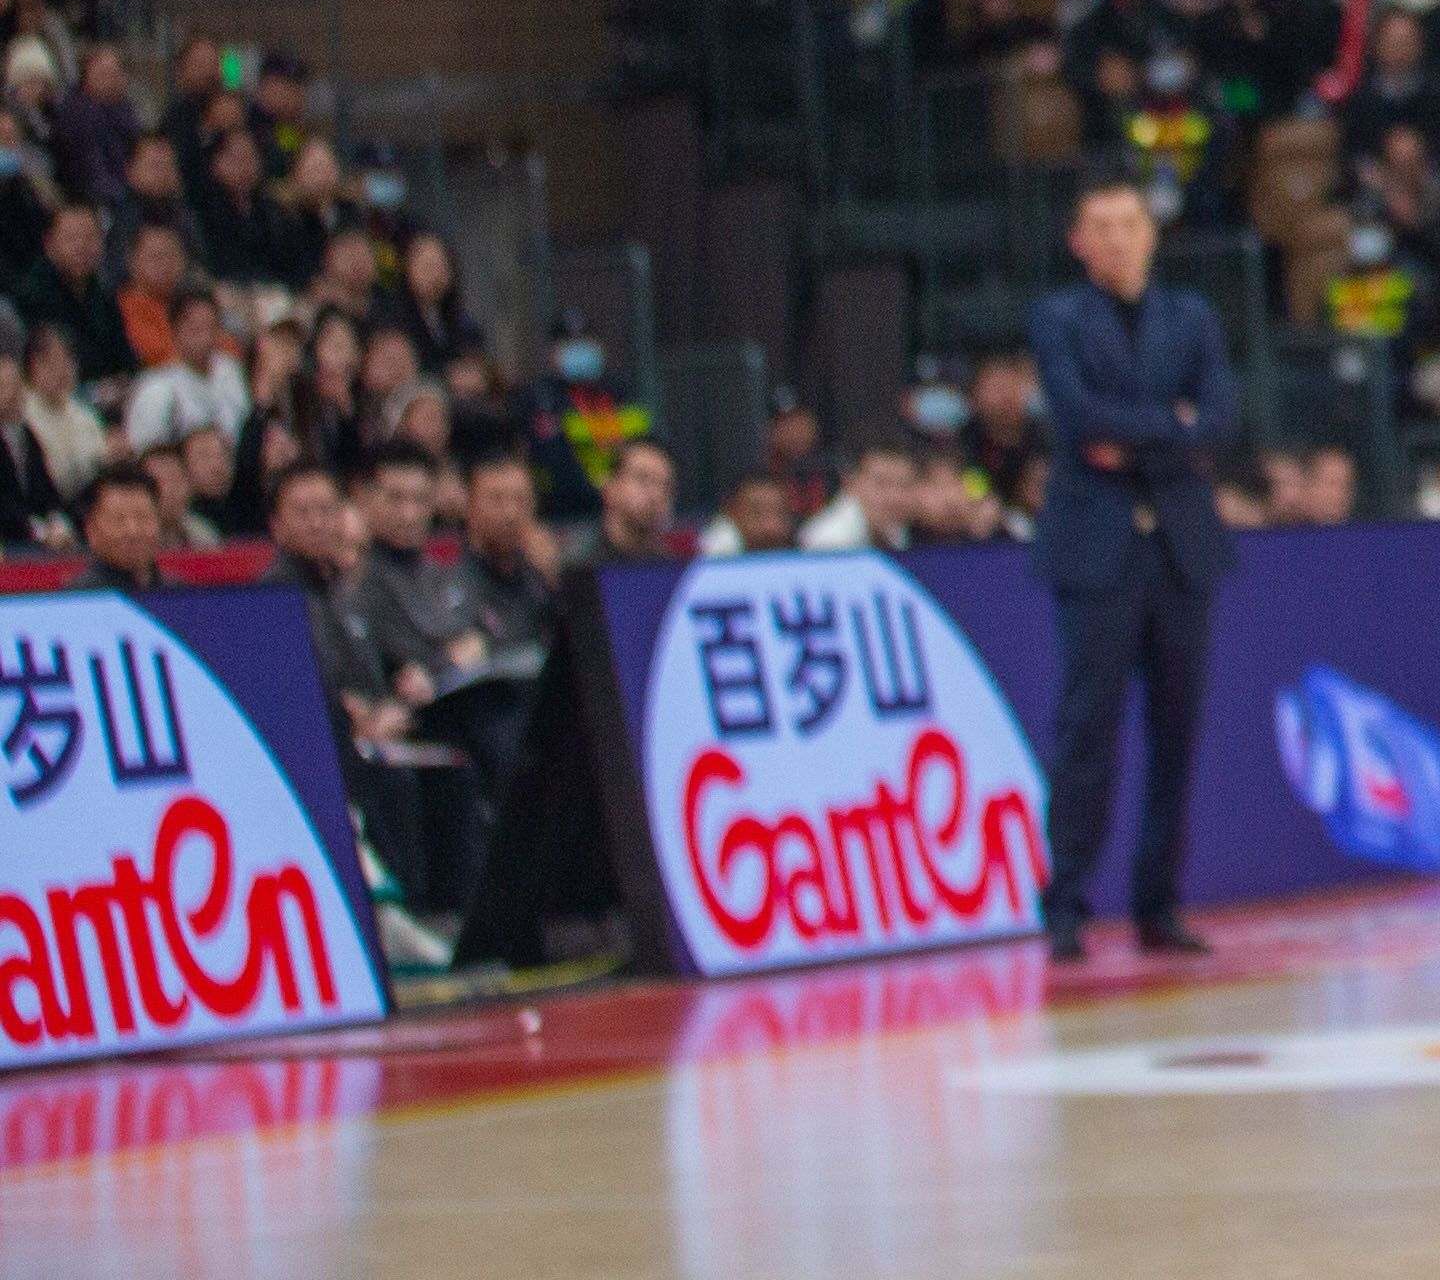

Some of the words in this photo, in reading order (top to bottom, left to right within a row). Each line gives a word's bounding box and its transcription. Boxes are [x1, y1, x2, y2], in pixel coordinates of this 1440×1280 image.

[689, 590, 937, 740] 百岁山
[683, 726, 1053, 952] Ganten
